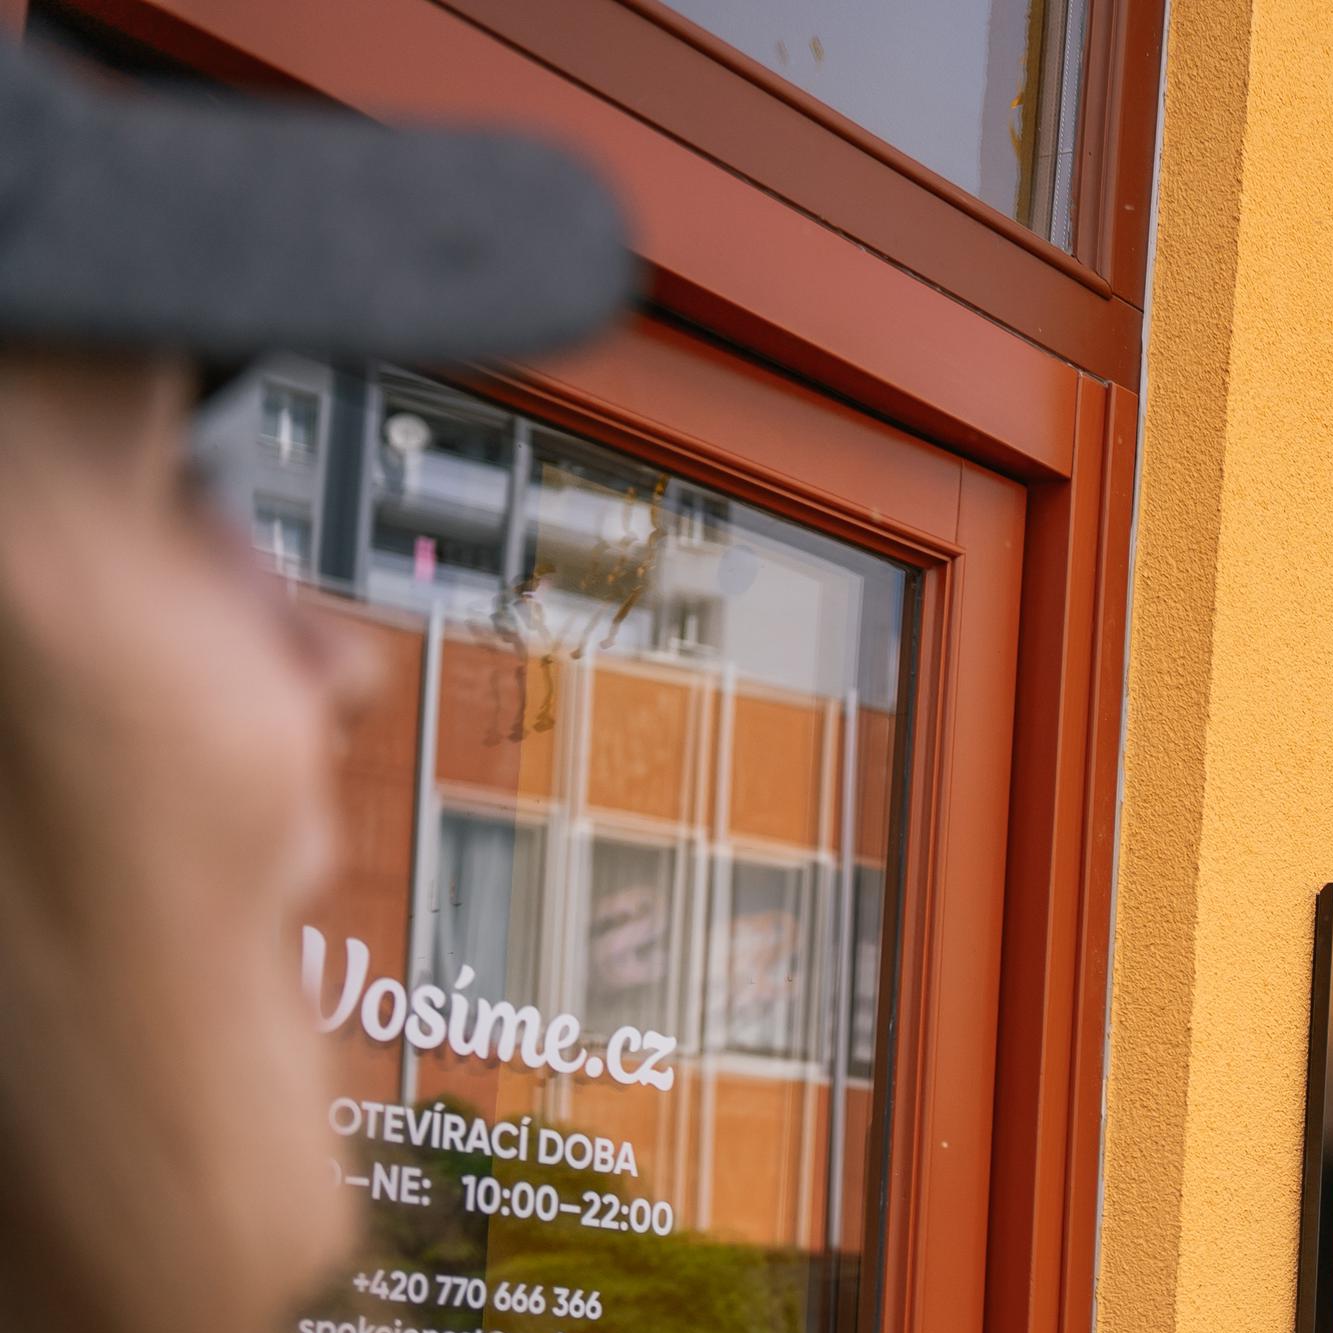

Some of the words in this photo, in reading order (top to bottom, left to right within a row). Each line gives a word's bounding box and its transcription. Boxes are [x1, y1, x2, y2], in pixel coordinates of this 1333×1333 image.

[302, 925, 676, 1091] Vosíme.cz
[328, 1097, 532, 1161] OTEVÍRACÍ
[537, 1127, 639, 1177] DOBA
[462, 1174, 674, 1236] 10:00–22:00
[353, 1269, 429, 1304] +420
[435, 1274, 487, 1309] 770
[493, 1281, 546, 1315] 666
[551, 1286, 603, 1320] 366
